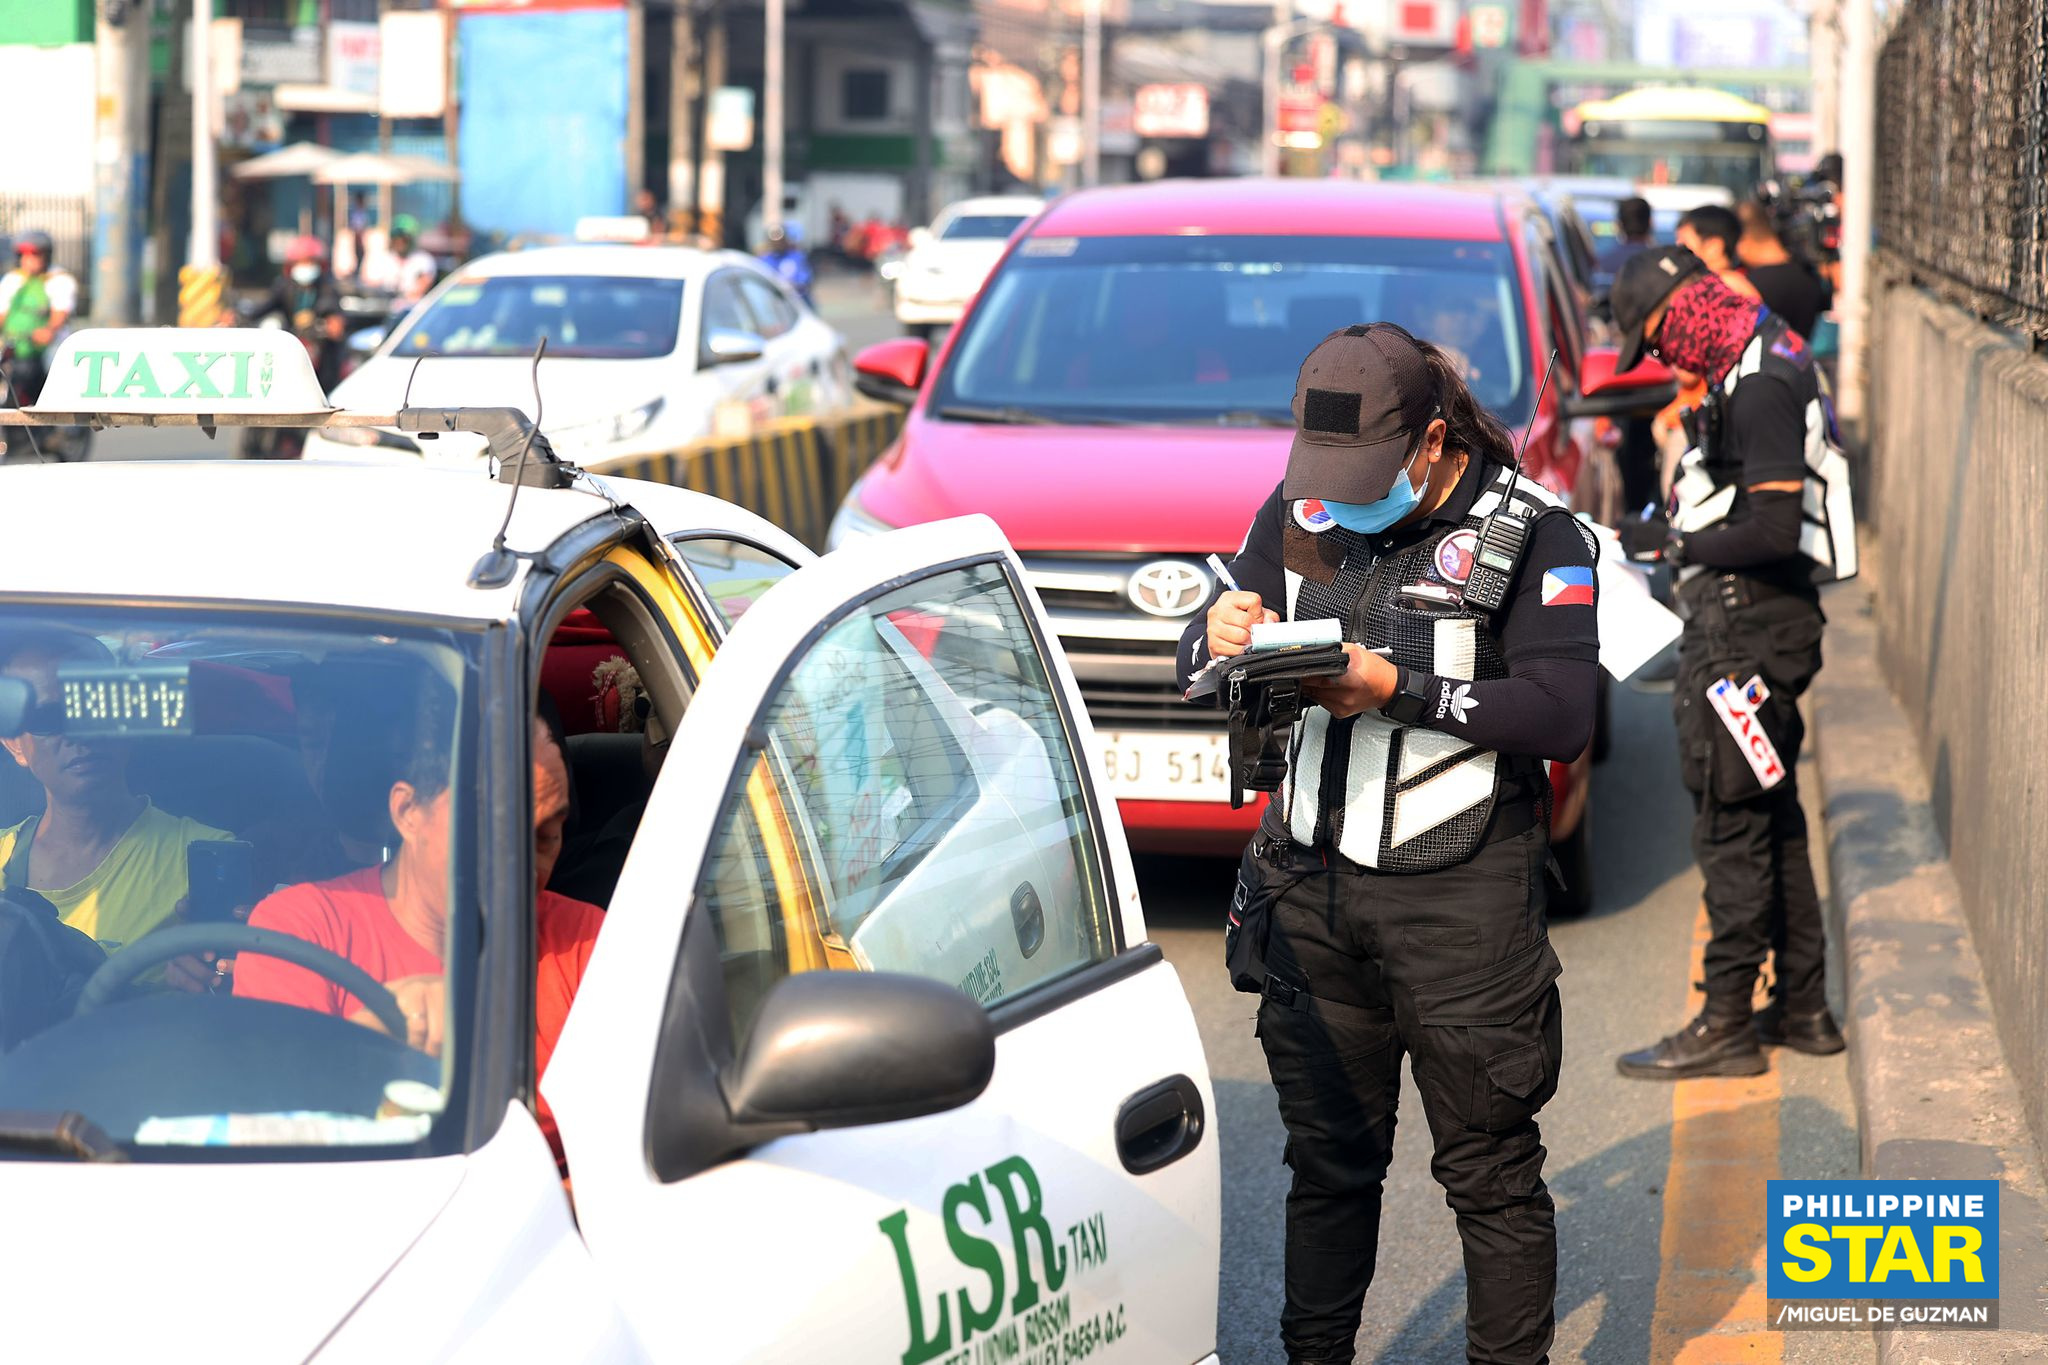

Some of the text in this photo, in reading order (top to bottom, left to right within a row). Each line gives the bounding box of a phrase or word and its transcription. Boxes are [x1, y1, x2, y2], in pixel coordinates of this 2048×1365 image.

[74, 351, 255, 398] TAXI
[1435, 681, 1451, 719] adidas
[878, 1155, 1107, 1365] LSR TAXI
